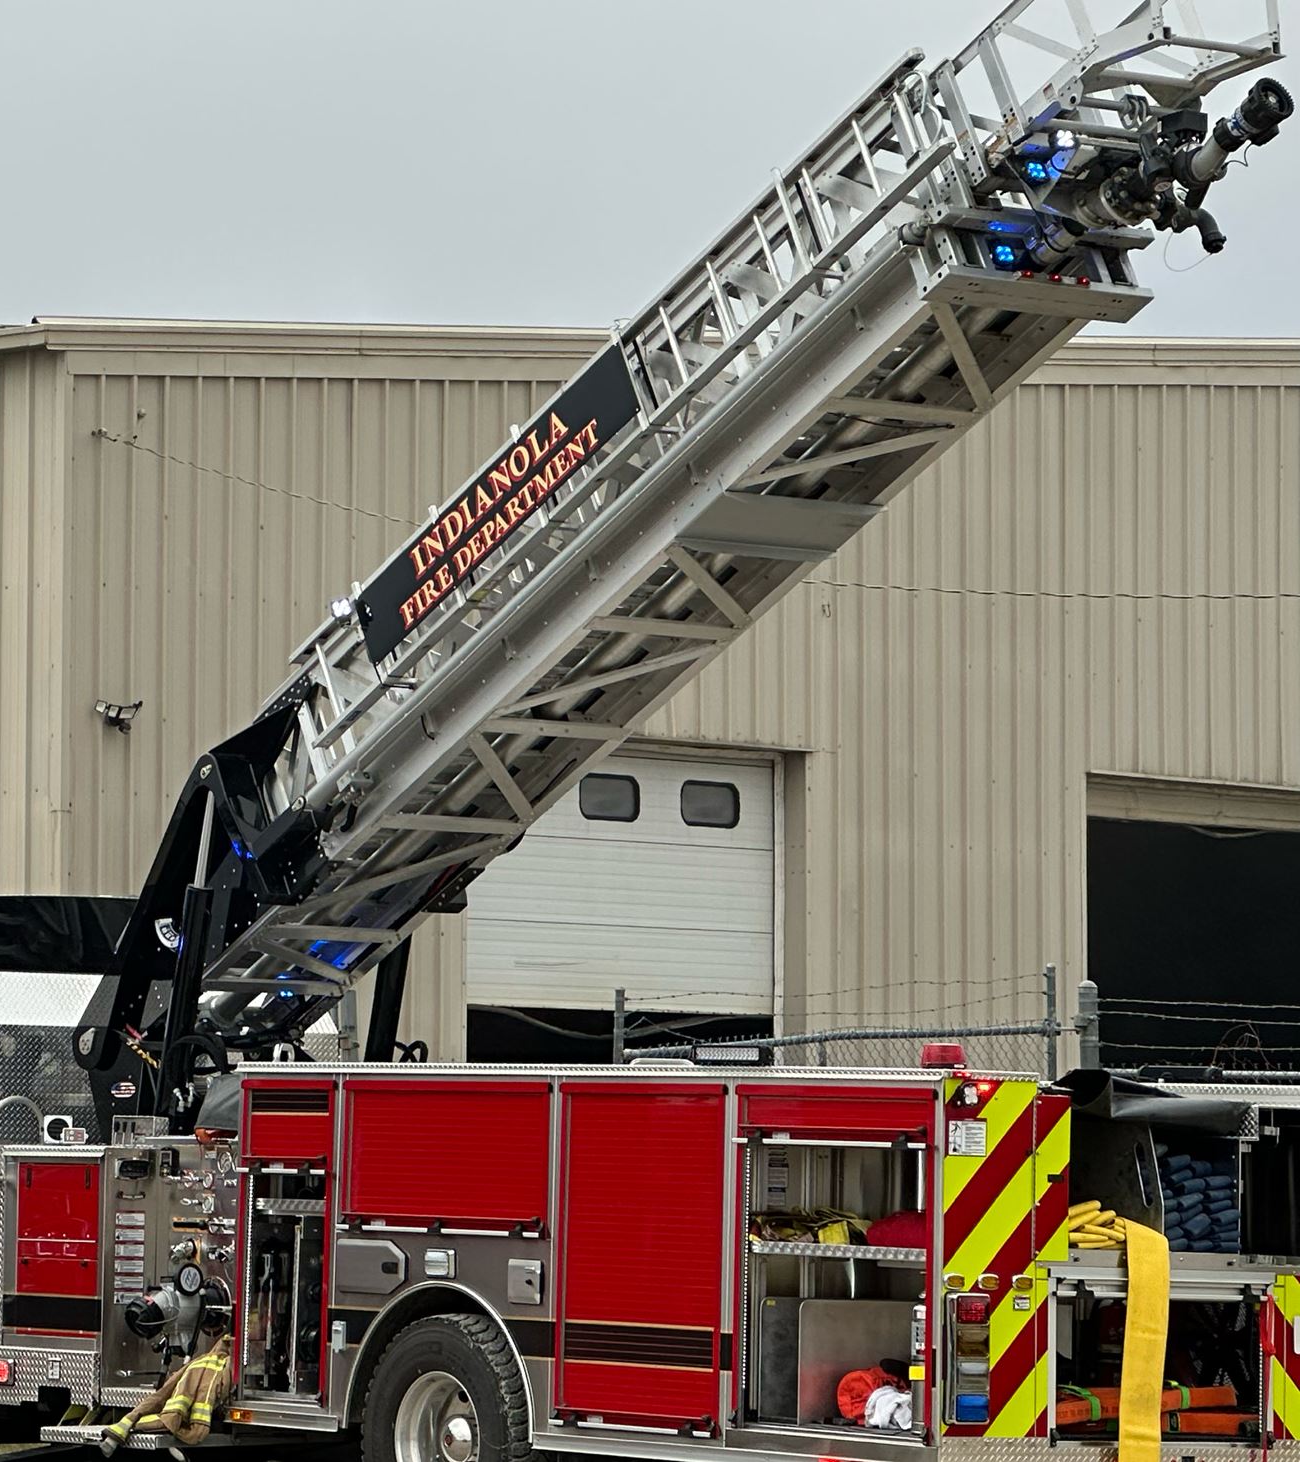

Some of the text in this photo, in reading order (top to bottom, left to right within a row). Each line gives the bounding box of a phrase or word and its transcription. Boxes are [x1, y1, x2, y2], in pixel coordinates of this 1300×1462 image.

[399, 418, 599, 630] FIRE DEPARTMENT
[409, 412, 569, 580] INDIANOLA
